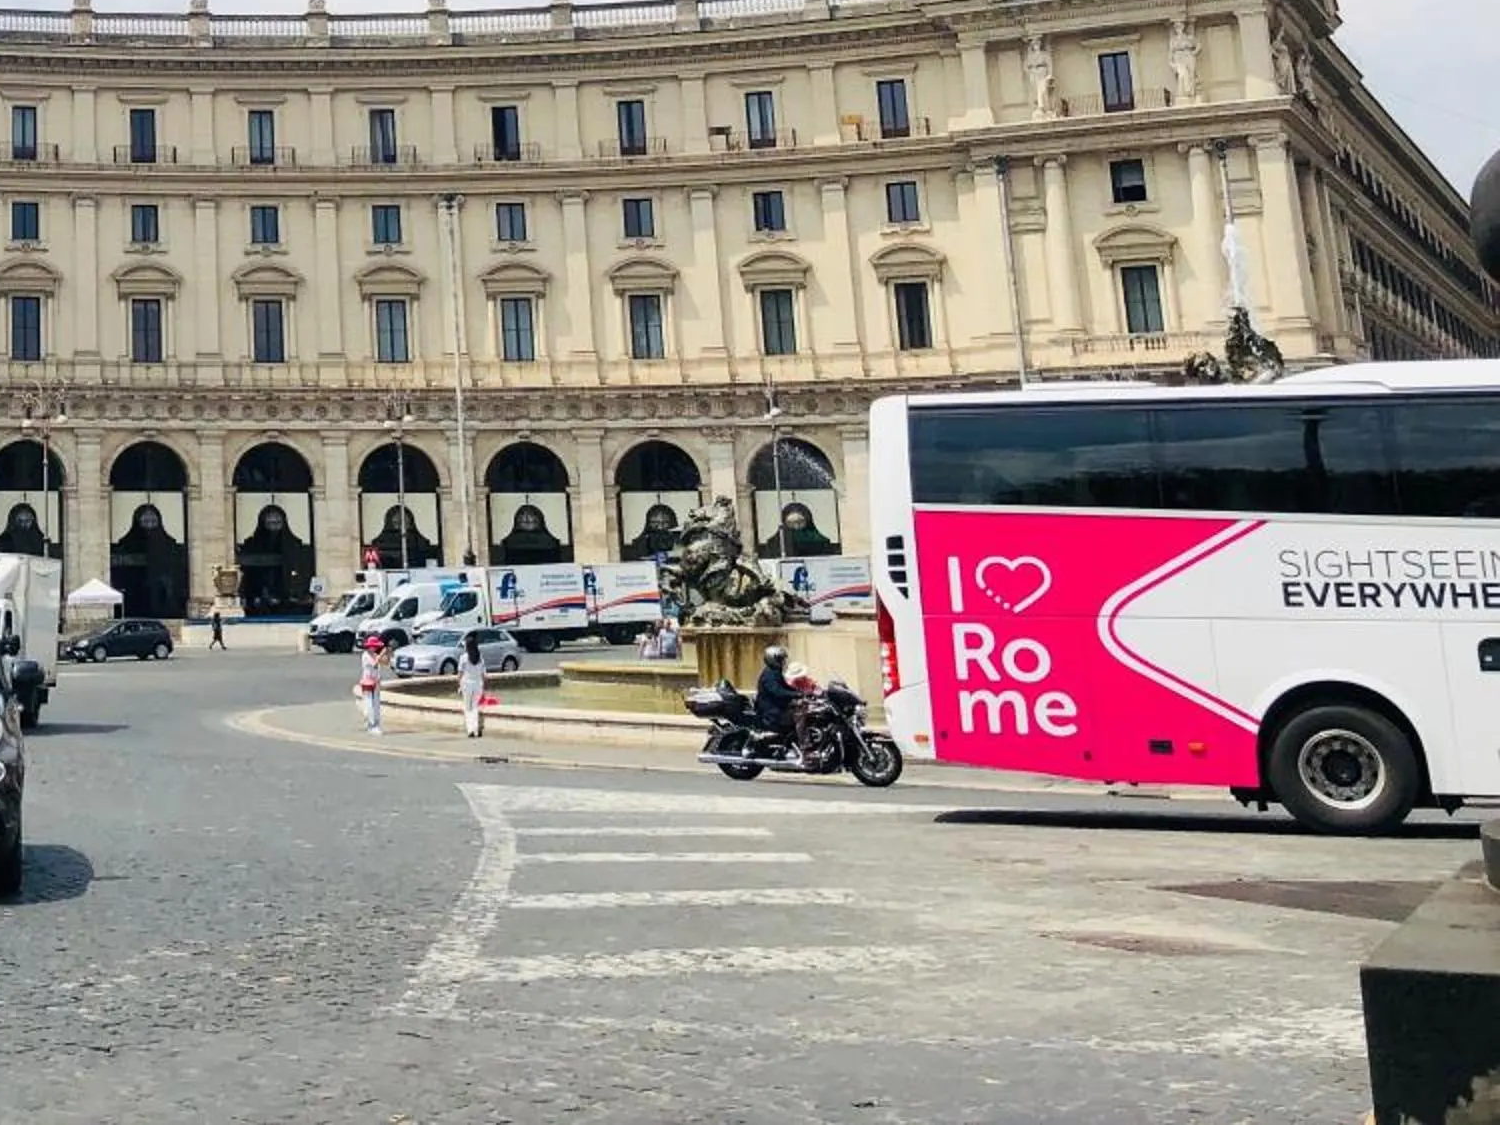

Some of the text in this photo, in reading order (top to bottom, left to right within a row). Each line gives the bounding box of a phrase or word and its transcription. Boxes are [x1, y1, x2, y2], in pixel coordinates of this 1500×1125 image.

[947, 555, 964, 613] I
[1281, 581, 1500, 608] EVERYWHE
[951, 622, 1051, 683] Ro
[958, 689, 1078, 736] me
